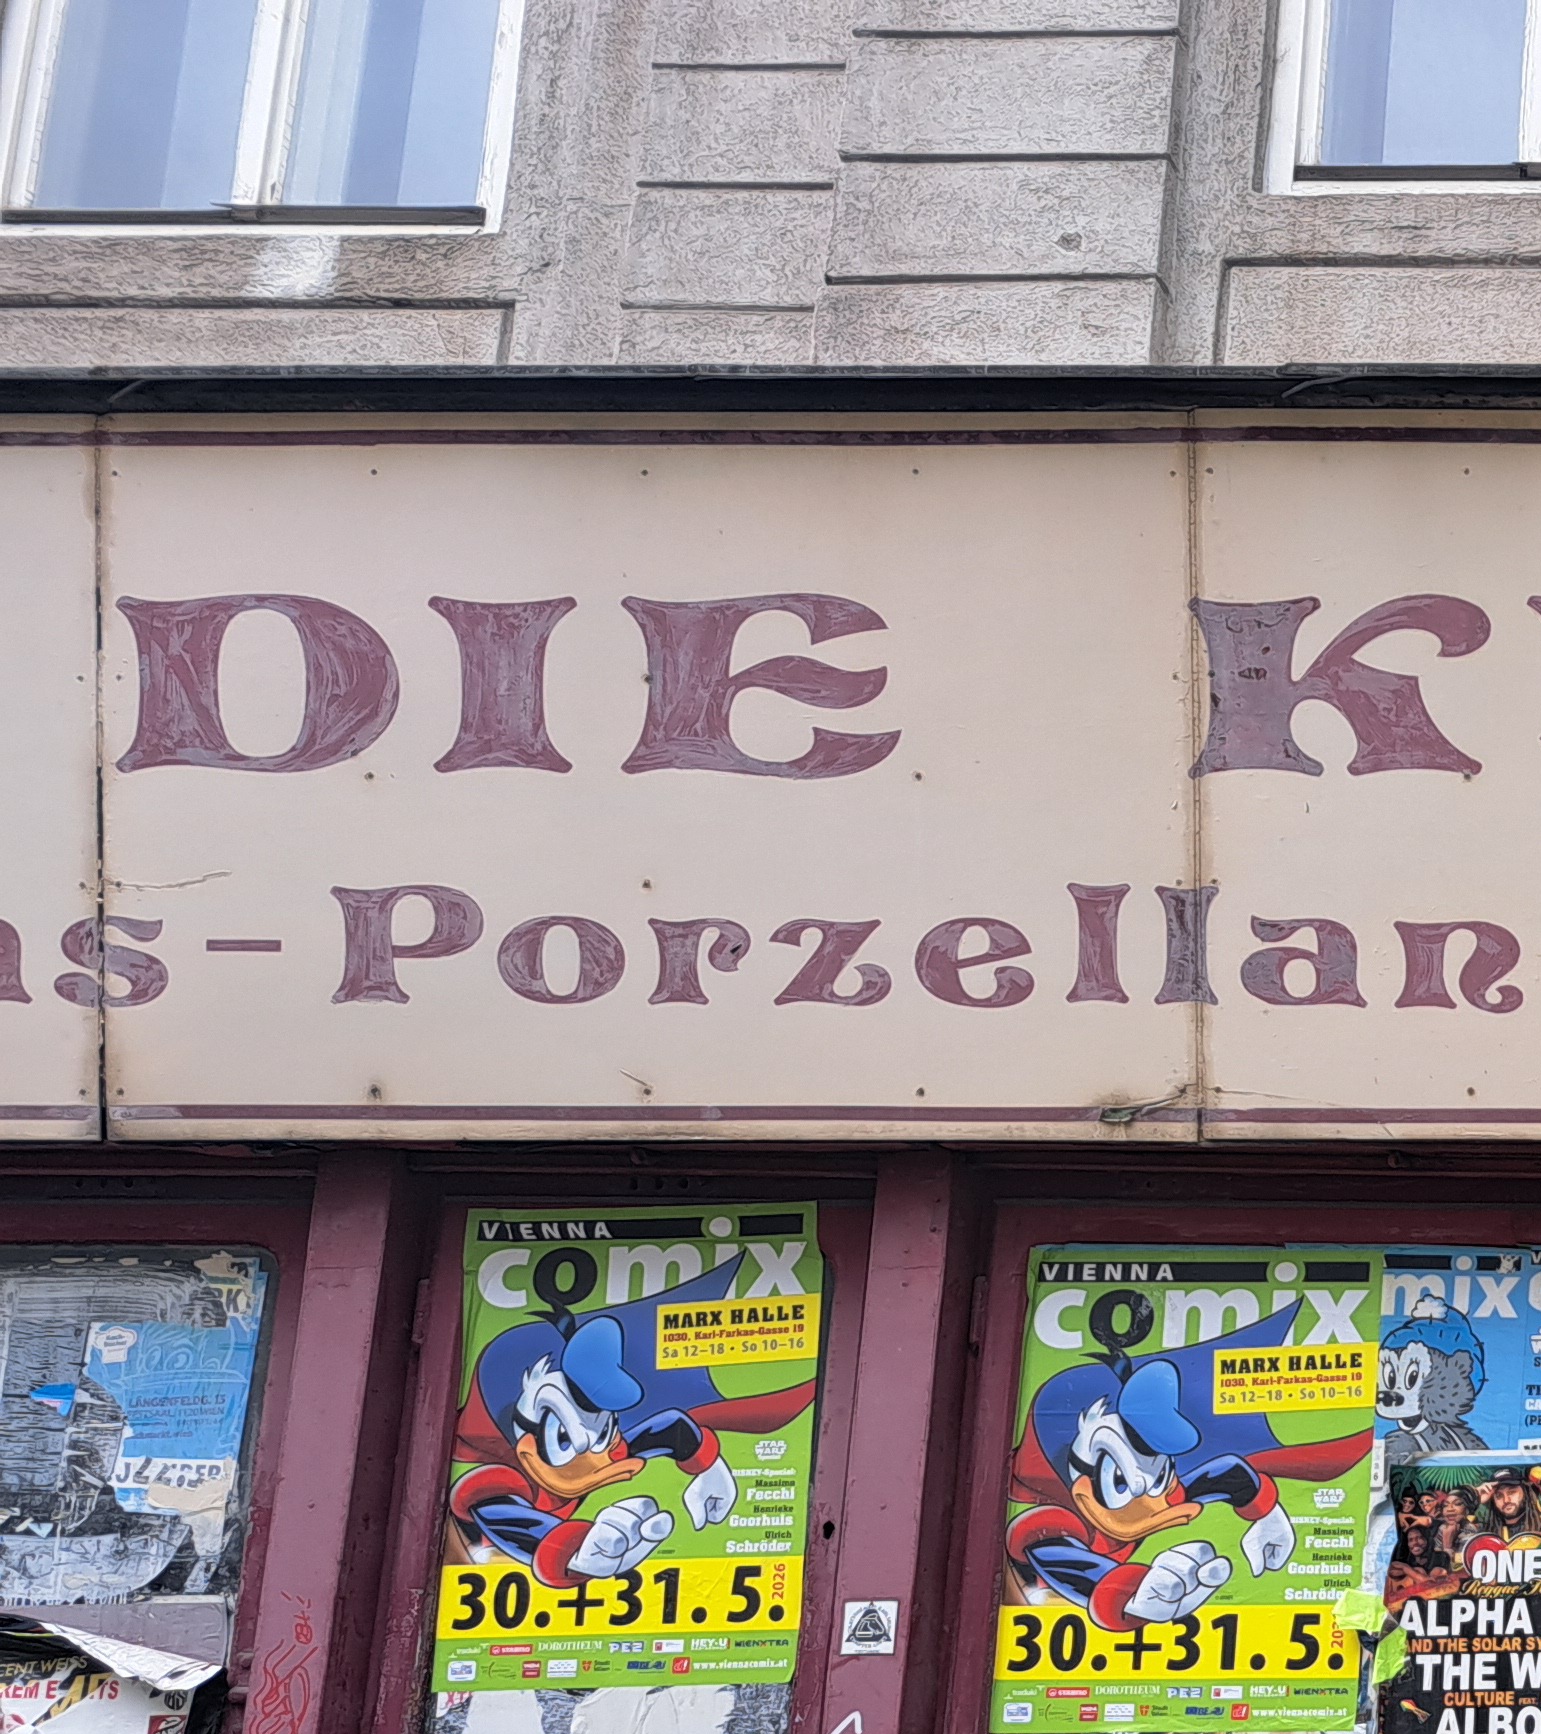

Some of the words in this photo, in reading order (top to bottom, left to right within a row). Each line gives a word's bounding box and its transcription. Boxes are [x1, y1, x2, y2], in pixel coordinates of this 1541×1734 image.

[116, 593, 902, 777] DIE
[481, 1222, 612, 1240] VIENNA
[477, 1215, 807, 1308] comix
[1042, 1262, 1175, 1281] VIENNA
[664, 1311, 722, 1329] MARX
[731, 1304, 804, 1324] HALLE
[1033, 1261, 1370, 1349] comix
[663, 1347, 678, 1358] Sa
[742, 1341, 757, 1352] So
[1220, 1357, 1280, 1374] MARX
[1289, 1353, 1362, 1371] HALLE
[771, 1562, 786, 1599] 2026
[1399, 1598, 1536, 1638] ALPHA
[1415, 1655, 1500, 1691] THE
[1444, 1692, 1514, 1707] CULTURE
